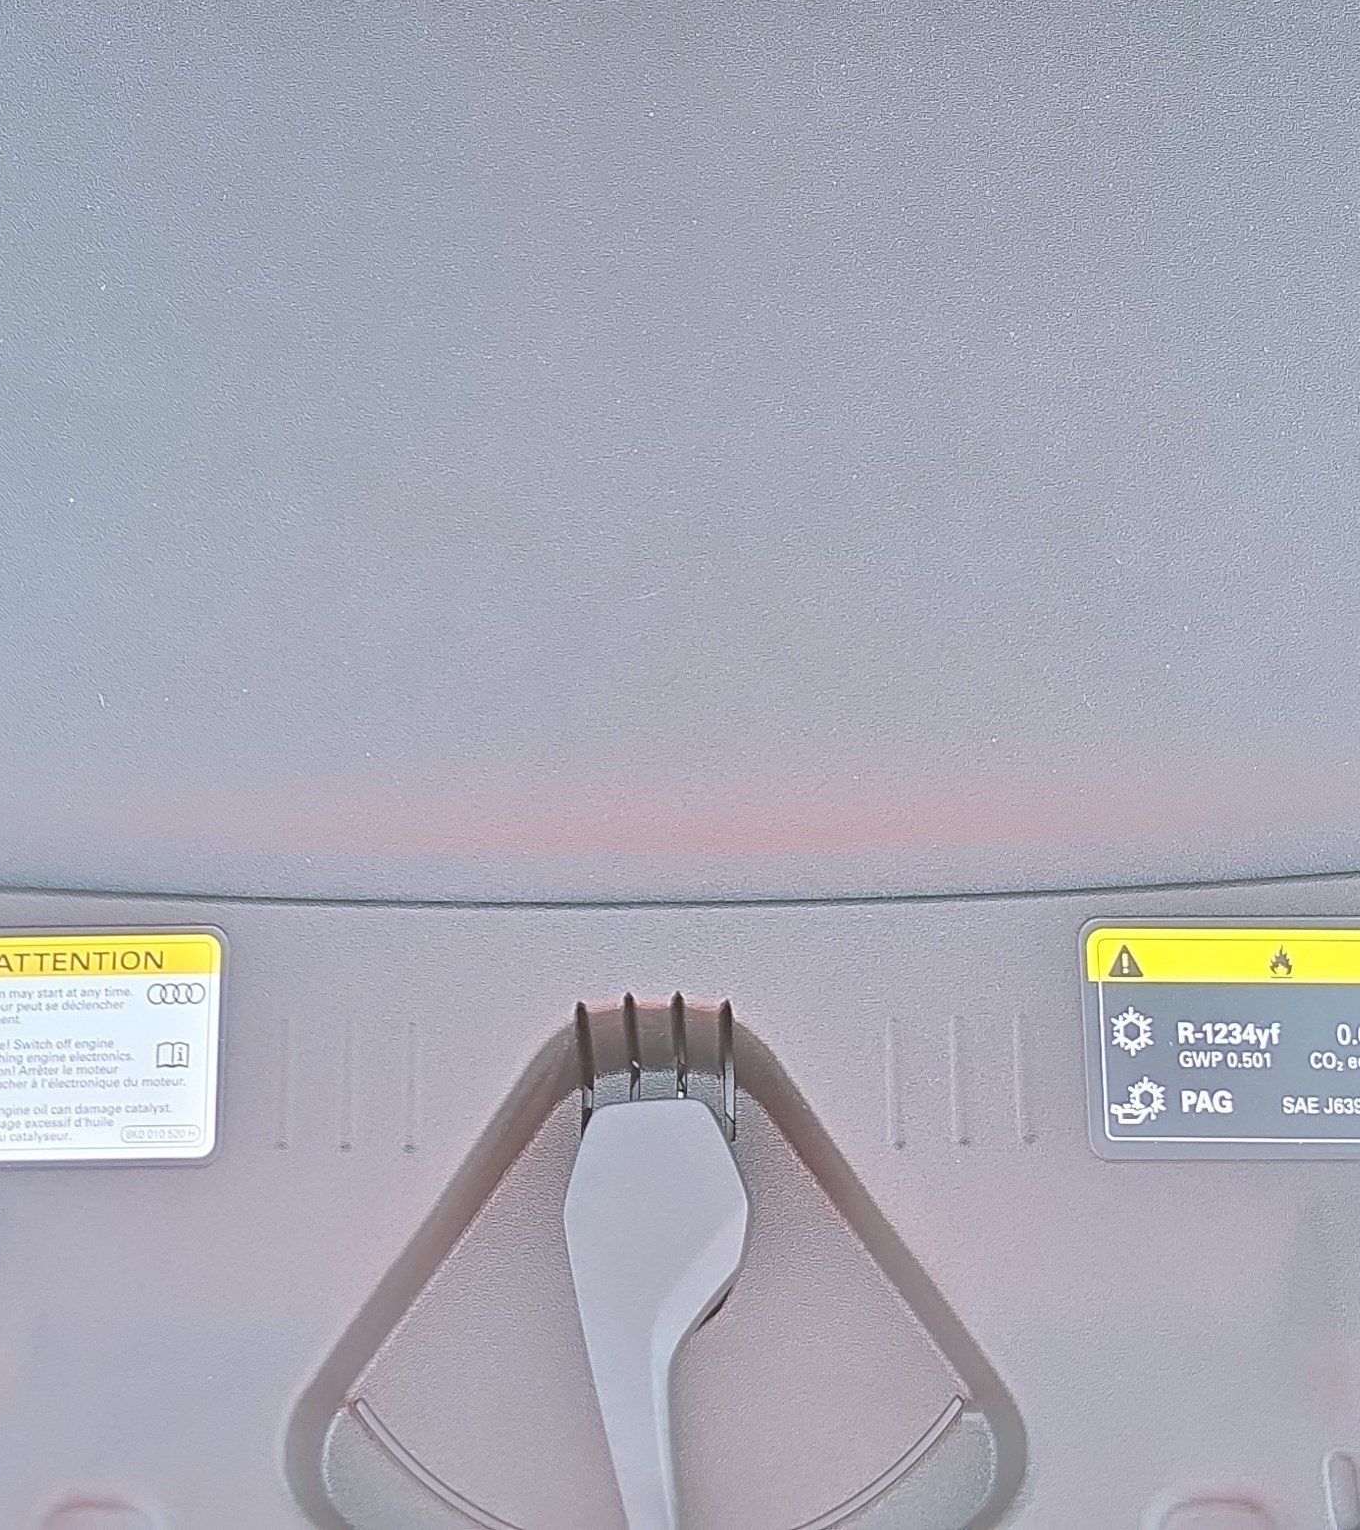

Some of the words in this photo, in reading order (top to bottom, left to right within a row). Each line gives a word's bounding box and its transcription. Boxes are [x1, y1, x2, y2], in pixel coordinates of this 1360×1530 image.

[9, 991, 33, 1002] may
[37, 989, 62, 999] start
[66, 989, 77, 998] at
[80, 989, 101, 999] any
[104, 987, 133, 998] time.
[1177, 1022, 1280, 1049] R-1234yf
[13, 1039, 52, 1050] Switch
[55, 1038, 72, 1049] off
[75, 1039, 114, 1052] engine
[26, 1052, 66, 1065] engine
[69, 1050, 135, 1062] electronics.
[1179, 1051, 1222, 1068] GWP
[1227, 1052, 1271, 1068] 0.501
[1181, 1090, 1234, 1114] PAG
[1282, 1097, 1319, 1114] SAE
[33, 1105, 47, 1116] oil
[51, 1105, 71, 1115] can
[75, 1104, 122, 1117] damage
[125, 1103, 172, 1115] catalyst.
